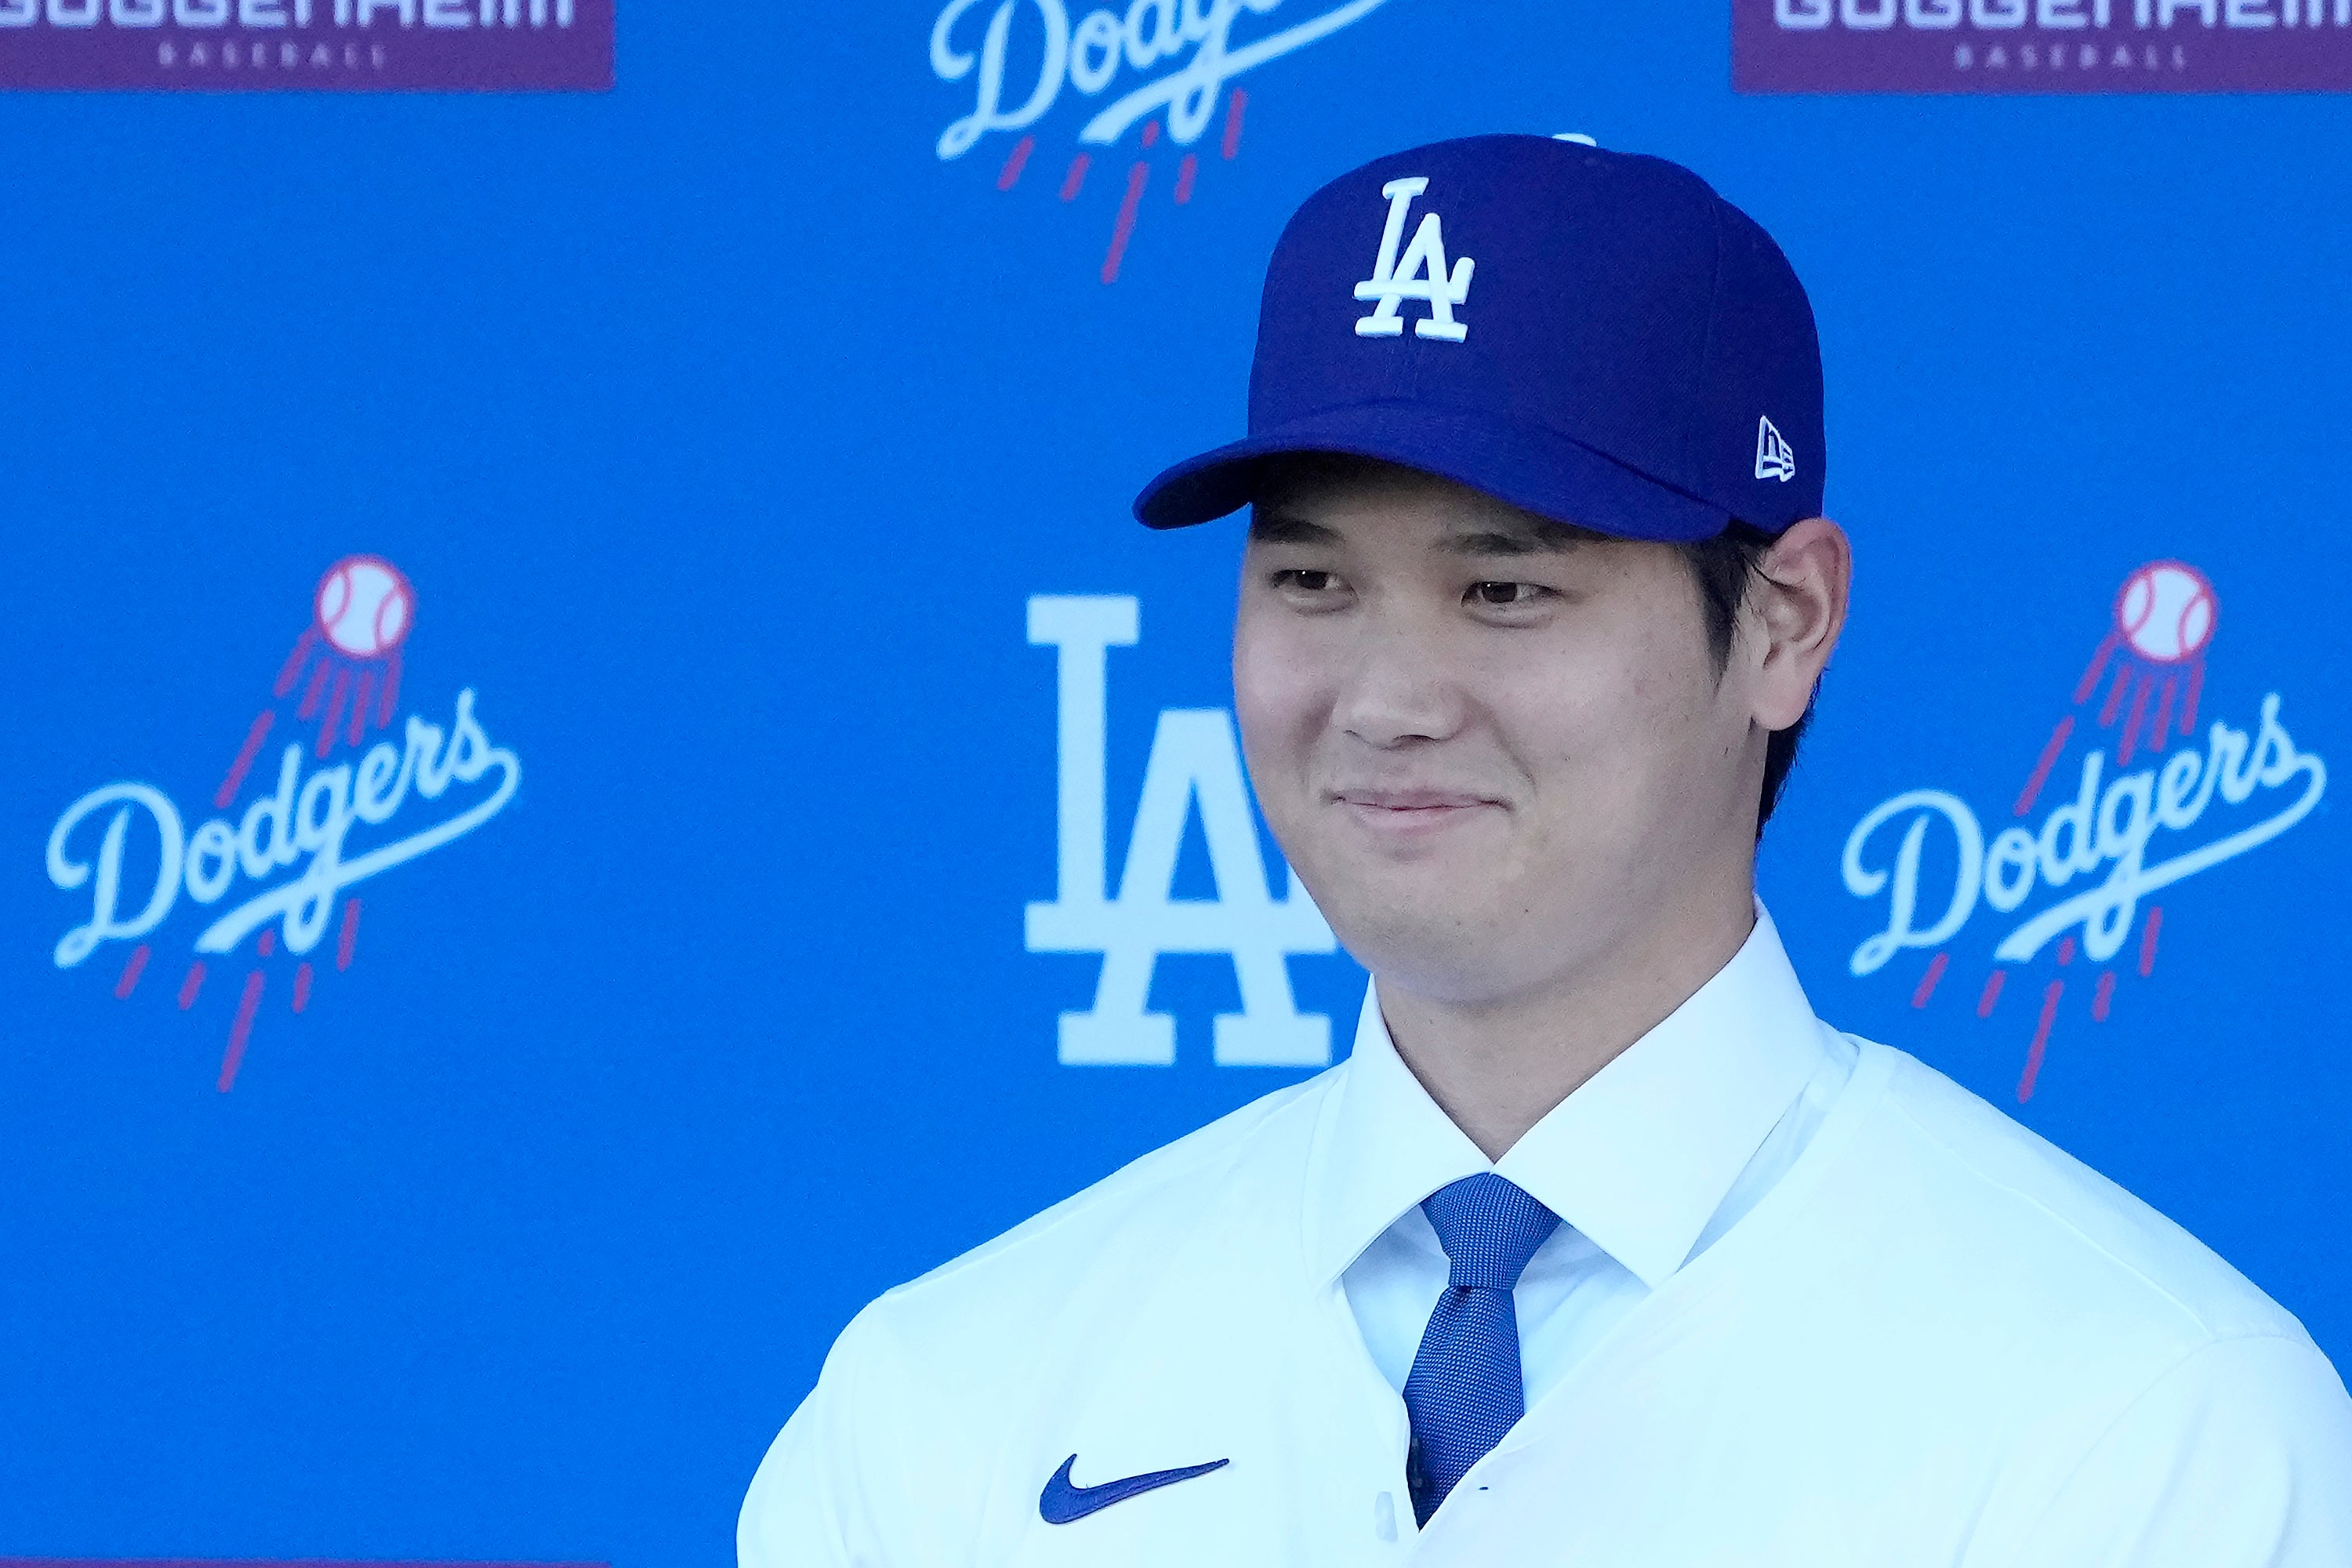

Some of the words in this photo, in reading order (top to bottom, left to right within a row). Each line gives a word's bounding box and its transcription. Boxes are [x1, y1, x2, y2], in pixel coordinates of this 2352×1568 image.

[1353, 176, 1475, 343] LA
[47, 688, 520, 967] Dodgers
[1025, 594, 1335, 1066] LA
[1842, 693, 2325, 976] Dodgers
